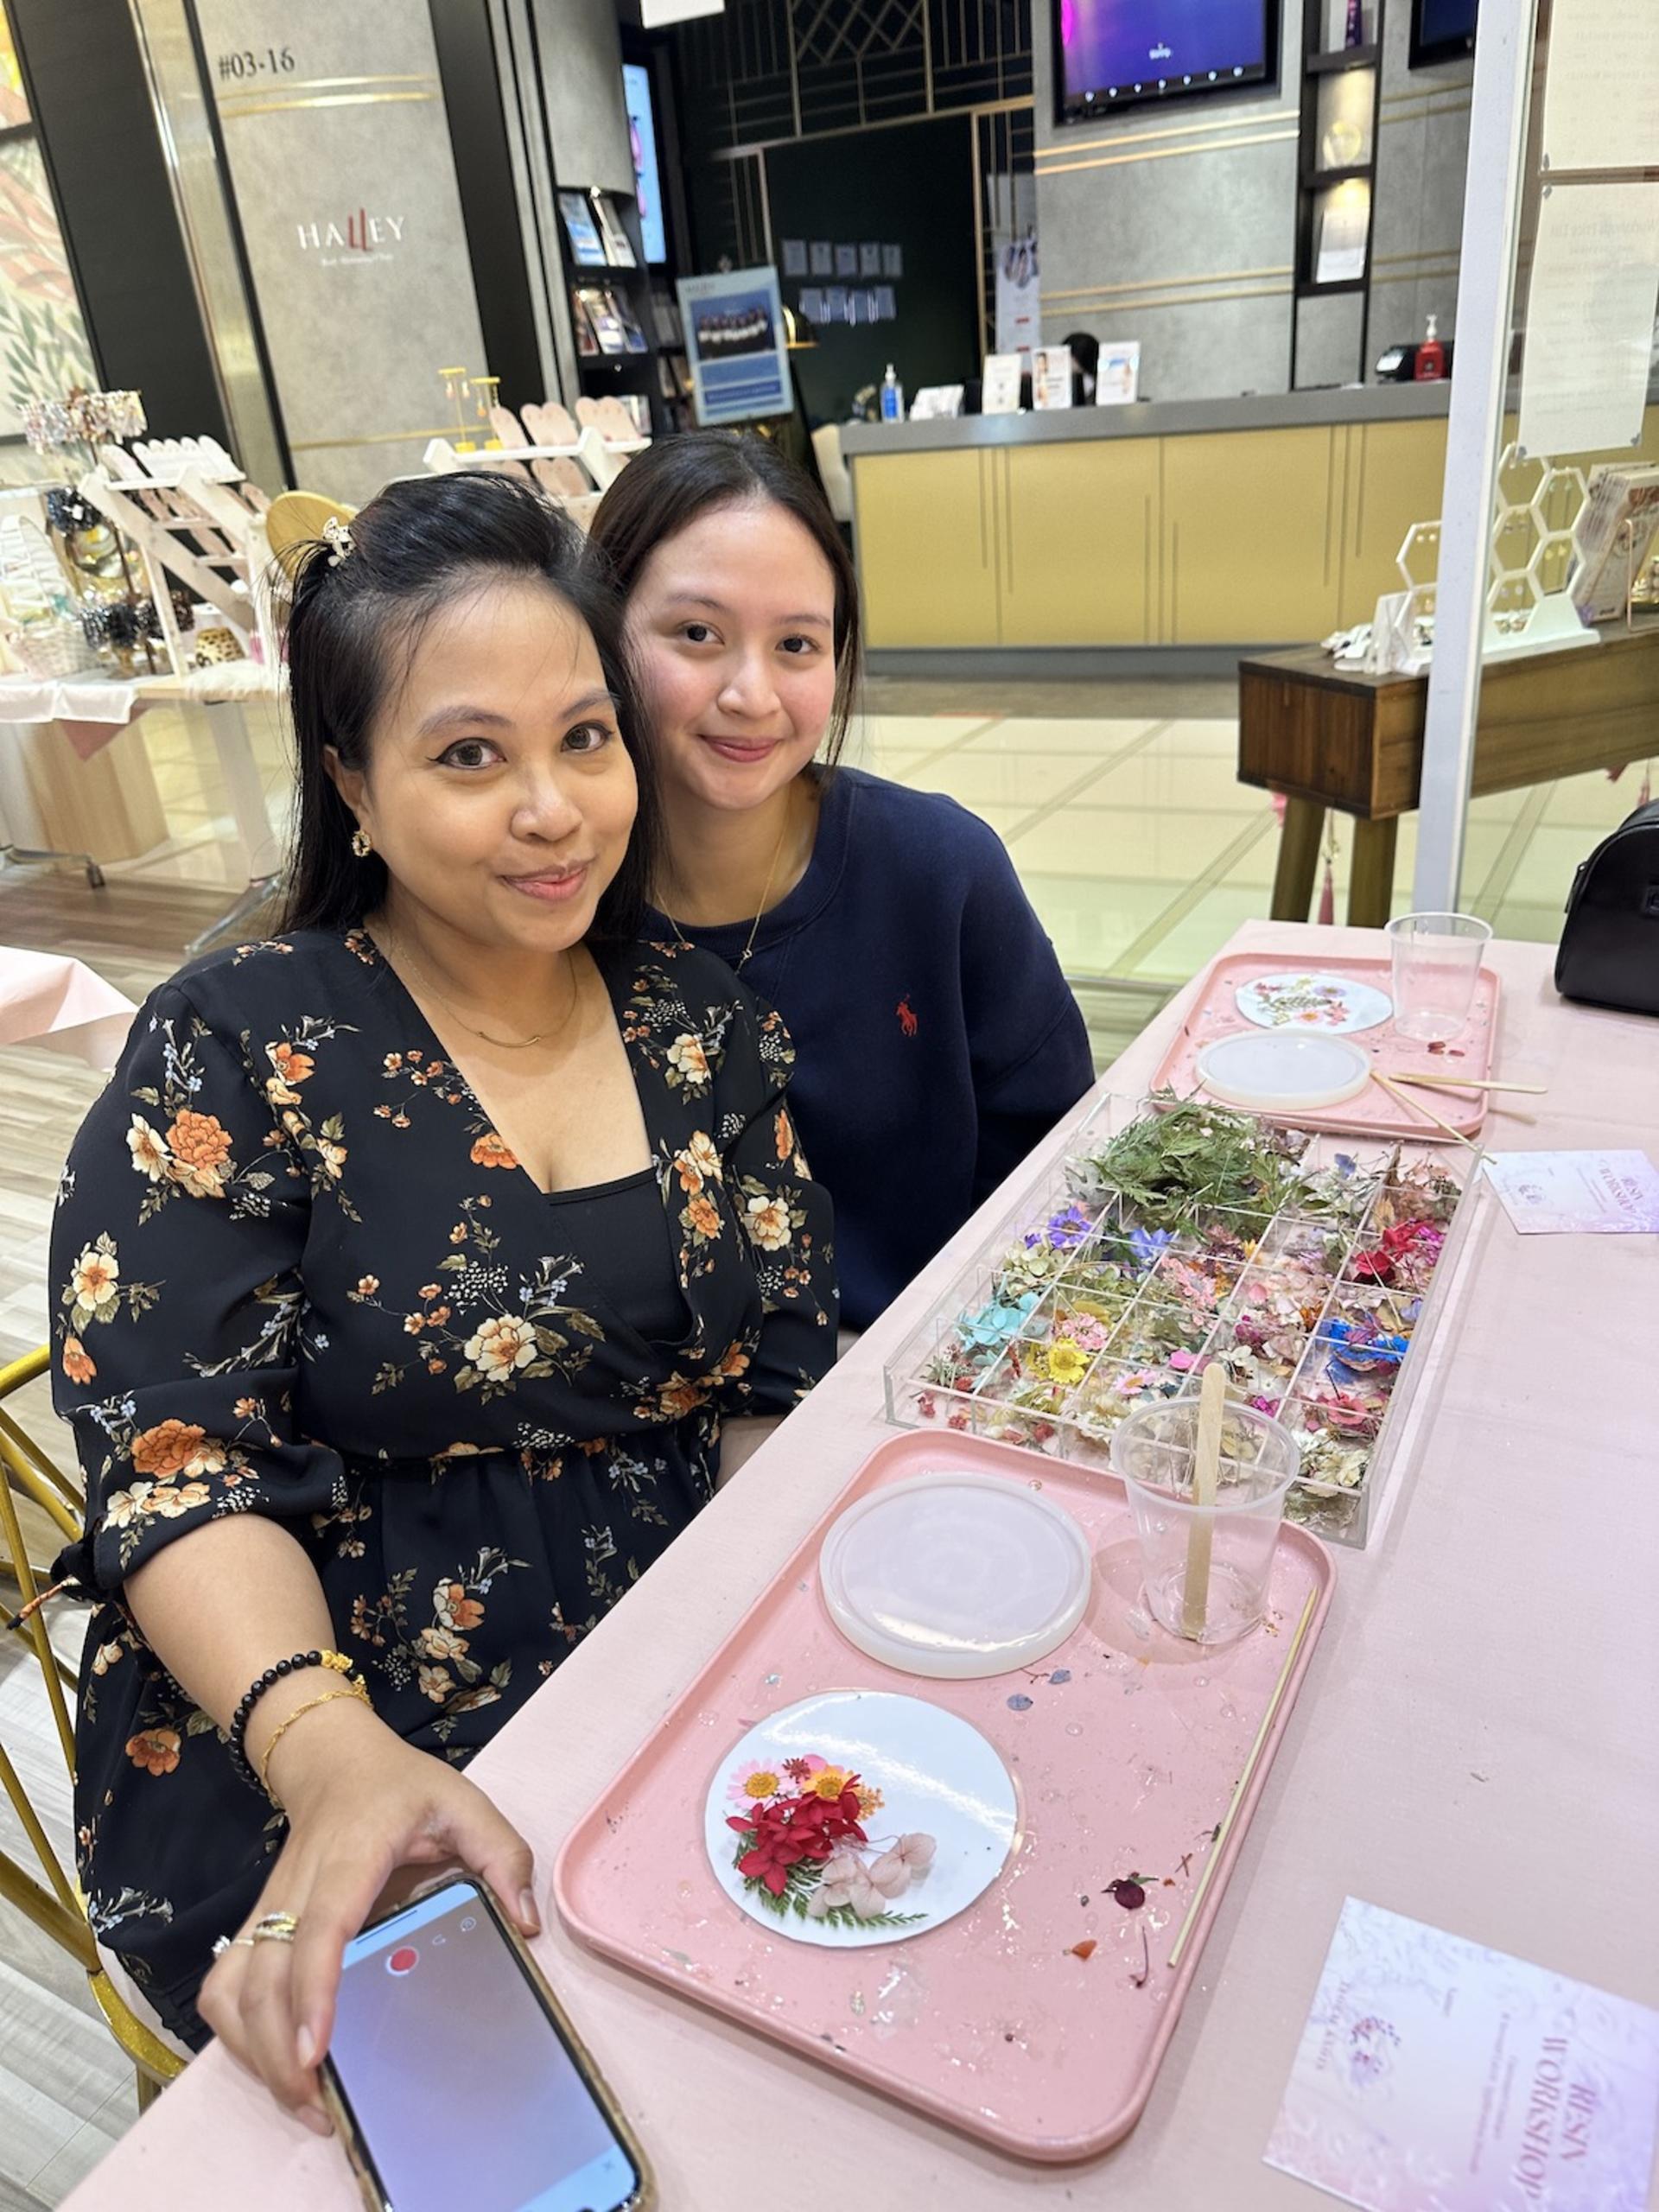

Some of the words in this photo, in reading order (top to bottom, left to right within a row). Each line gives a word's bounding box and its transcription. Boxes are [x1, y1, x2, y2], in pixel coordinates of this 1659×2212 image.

[219, 47, 296, 80] #03-16
[297, 207, 404, 251] HALLEY
[1513, 2036, 1568, 2200] WORKSHOP
[1560, 2082, 1596, 2160] RESIN
